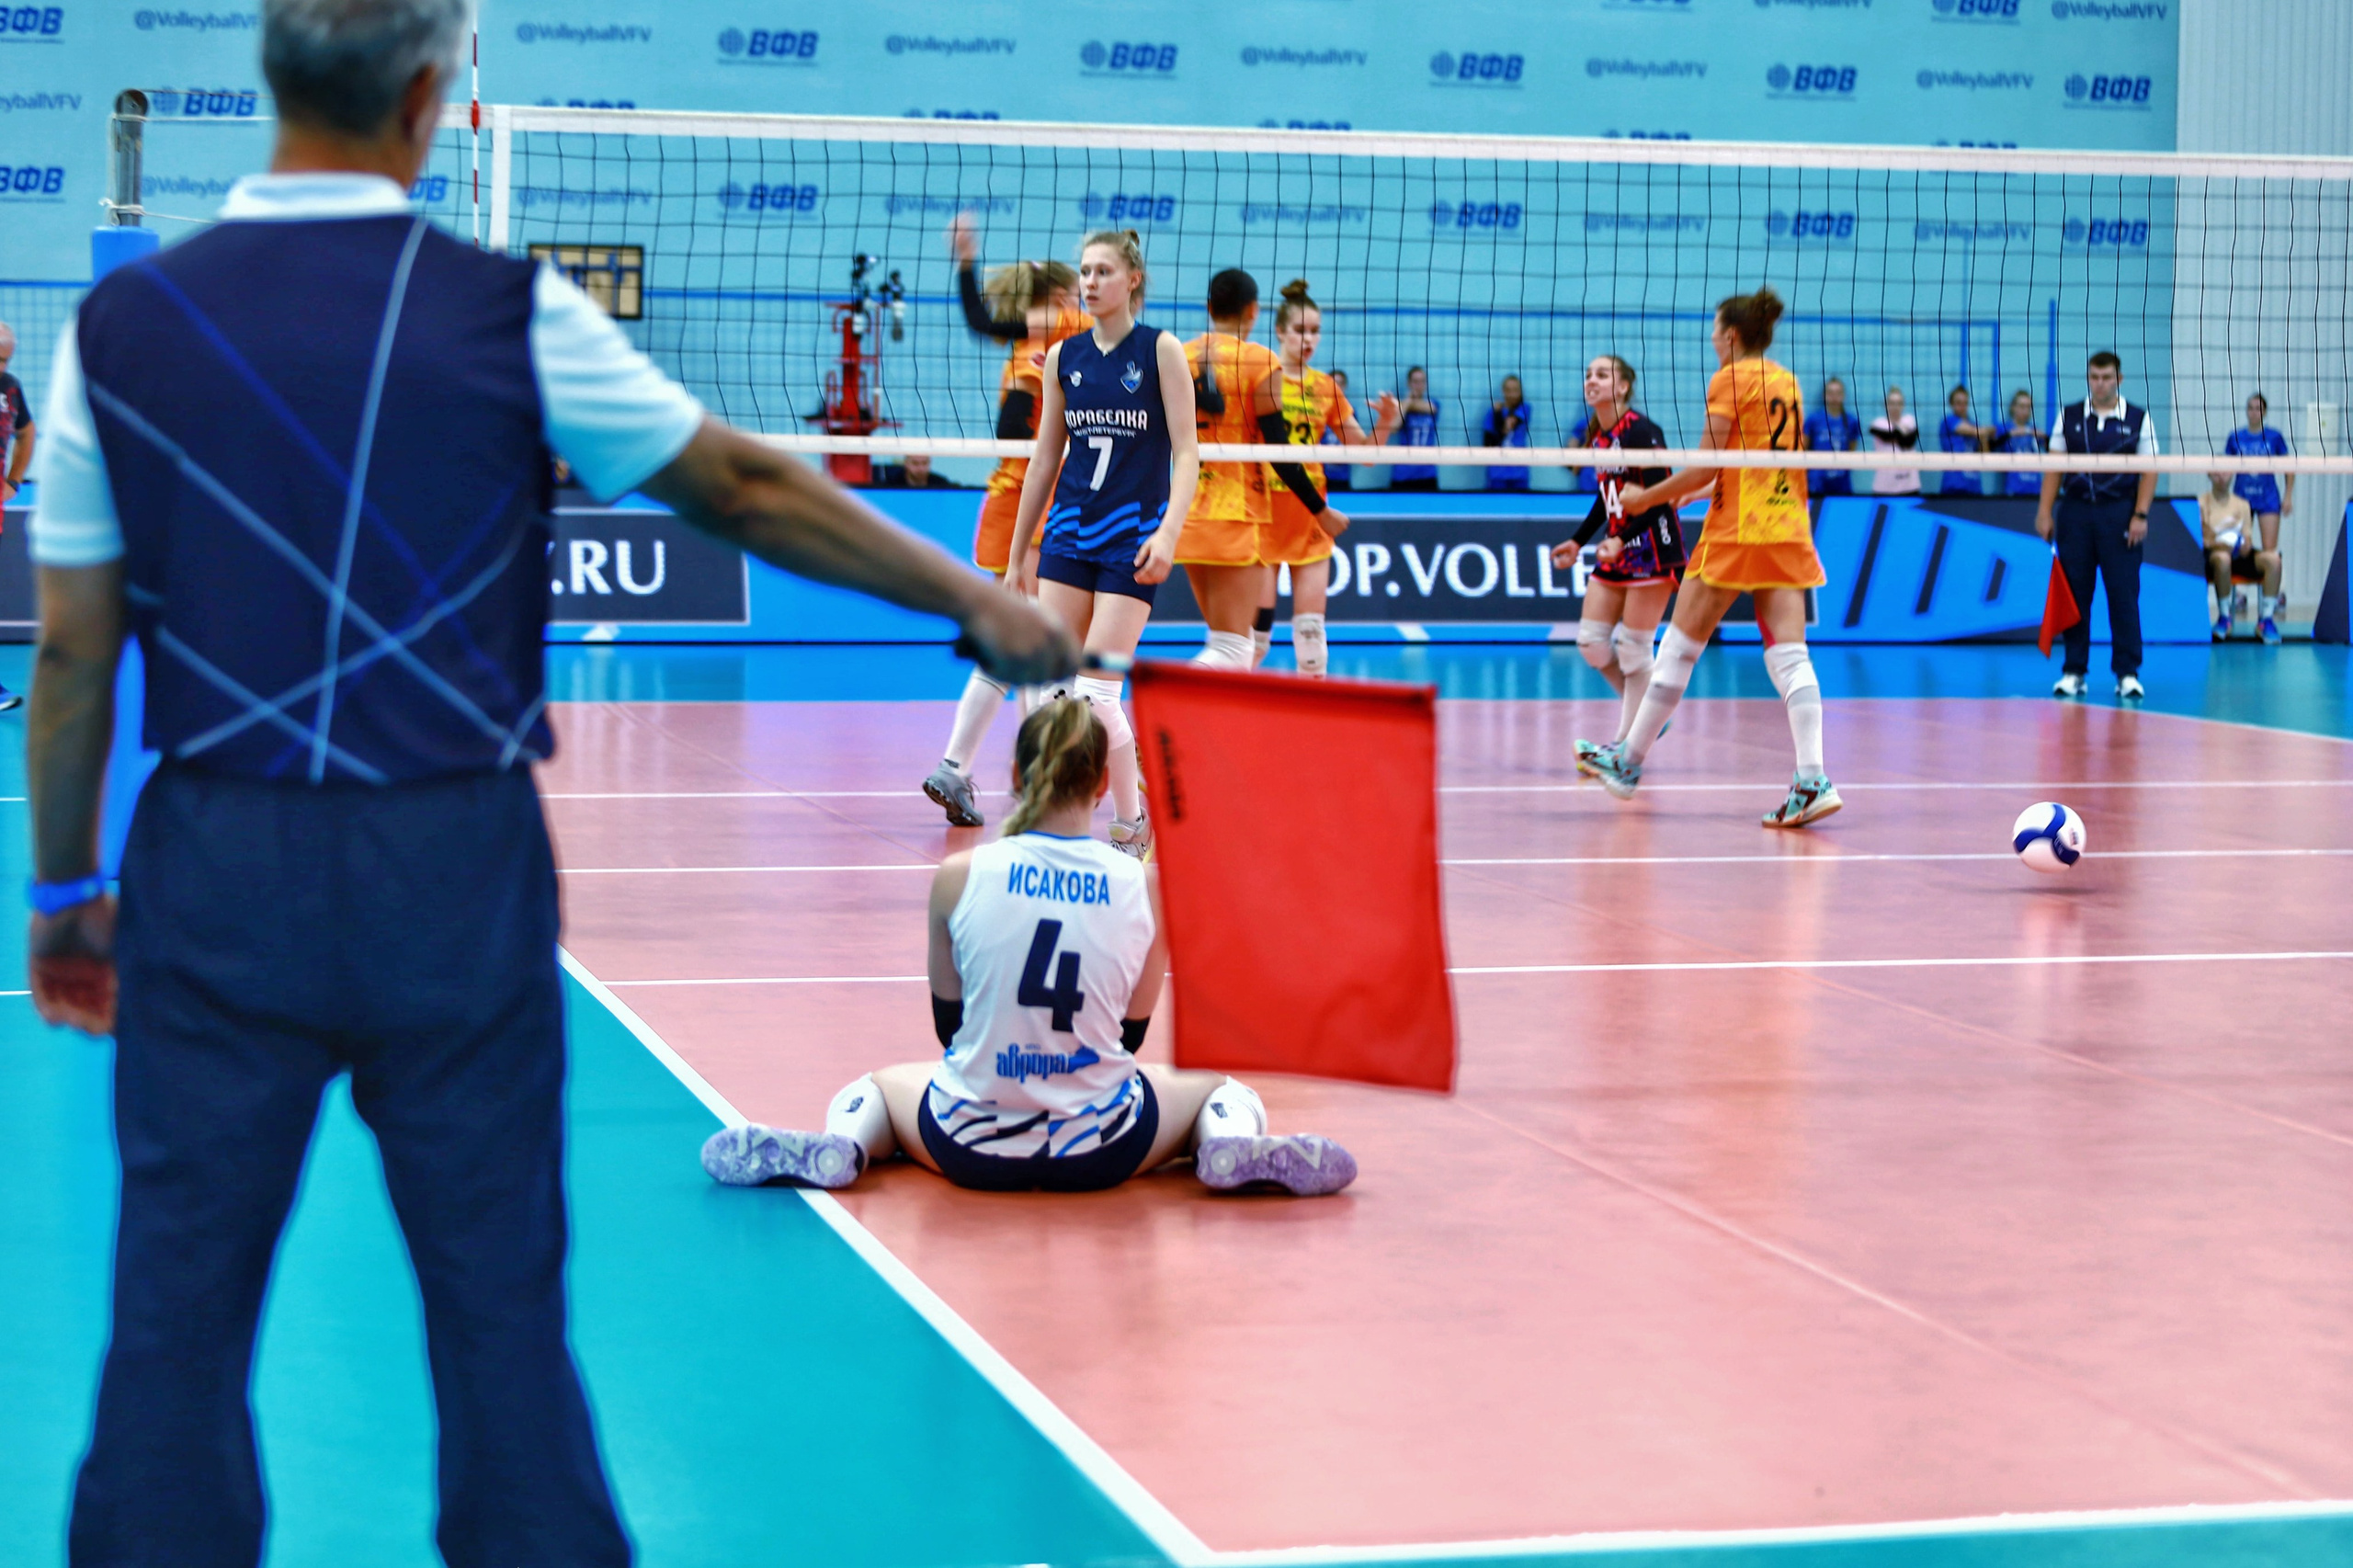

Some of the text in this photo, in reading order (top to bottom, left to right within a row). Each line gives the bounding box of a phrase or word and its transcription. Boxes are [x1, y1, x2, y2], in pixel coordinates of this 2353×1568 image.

[747, 29, 819, 58] ВФВ
[1108, 41, 1177, 72] ВФВ
[1458, 52, 1524, 82] ВФВ
[1793, 64, 1858, 93] ВФВ
[2089, 74, 2153, 103] ВФВ
[747, 184, 818, 211] ВФВ
[1108, 194, 1176, 222] ВФВ
[1456, 201, 1522, 230] ВФВ
[1790, 210, 1855, 239] ВФВ
[2087, 218, 2150, 247] ВФВ
[1088, 436, 1113, 492] 7
[549, 538, 666, 596] .RU
[1007, 862, 1110, 906] ИСАКОВА
[1017, 917, 1086, 1033] 4
